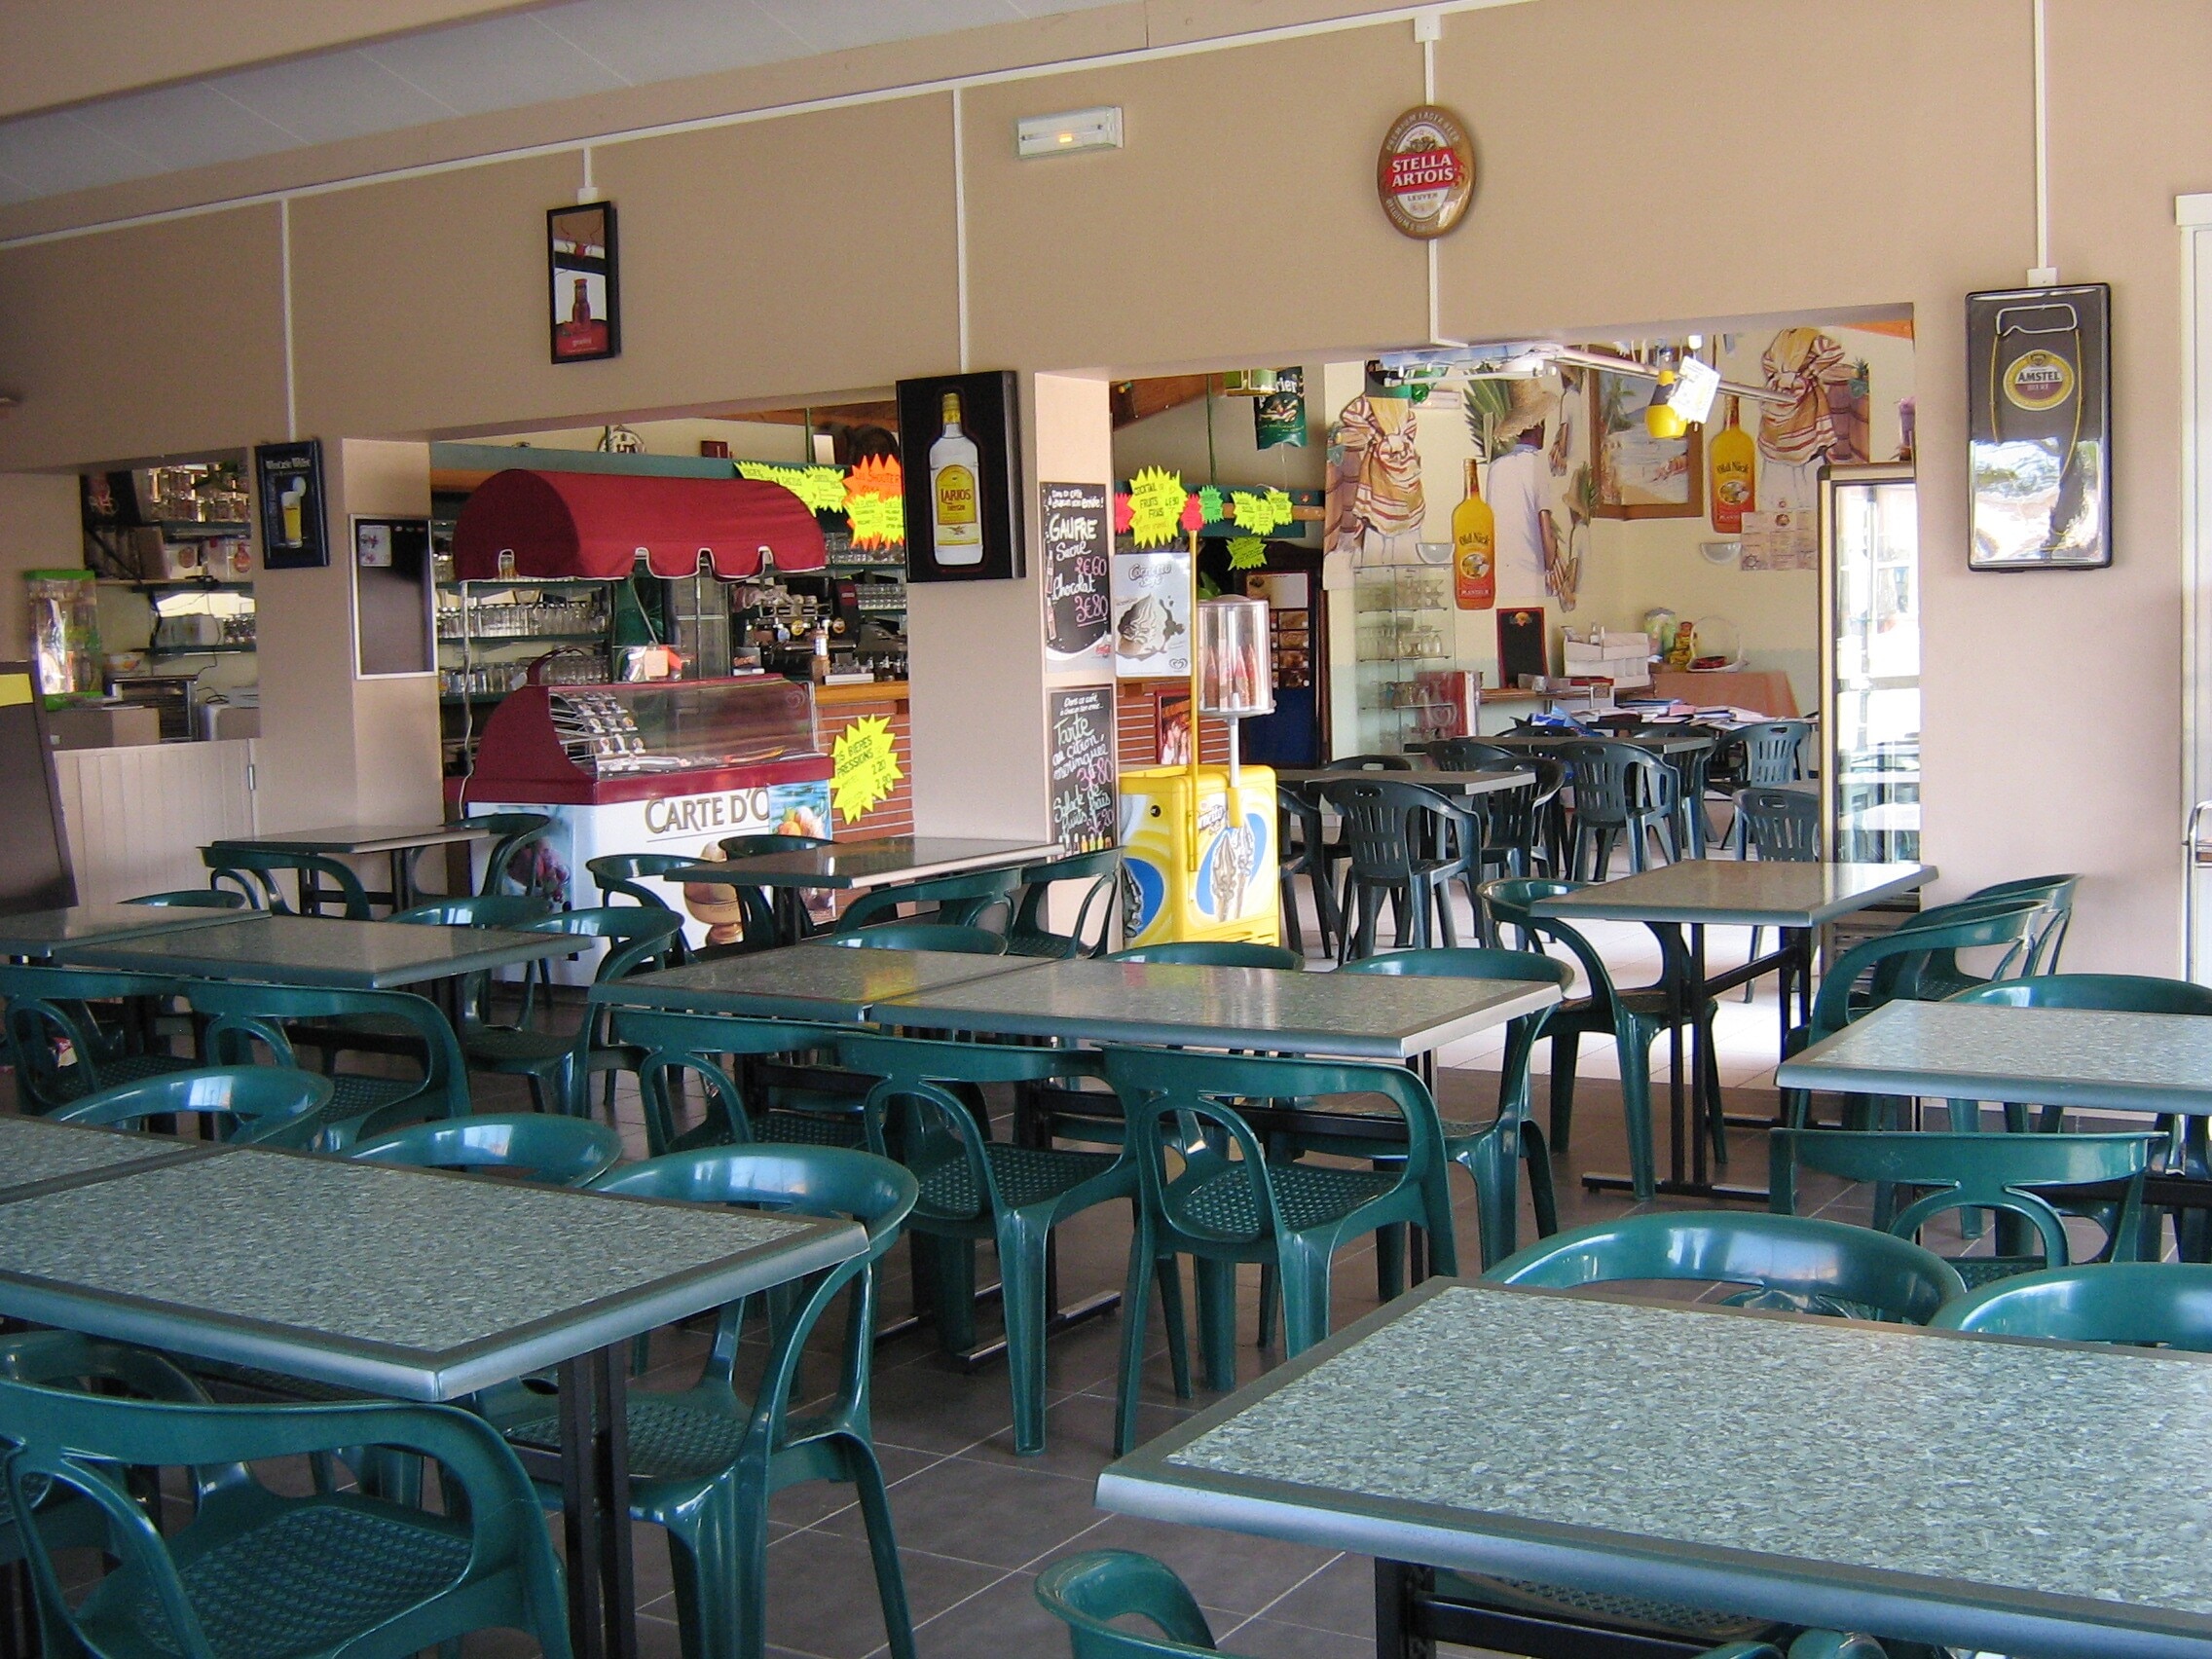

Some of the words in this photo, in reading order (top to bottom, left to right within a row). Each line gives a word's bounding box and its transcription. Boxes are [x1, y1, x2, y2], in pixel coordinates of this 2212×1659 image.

[1392, 154, 1452, 173] STELLA
[1392, 167, 1455, 188] ARTOIS
[1407, 192, 1438, 203] LEUVEN
[2018, 371, 2060, 383] AMSTEL
[1716, 462, 1731, 475] Old
[1732, 461, 1750, 473] Nick
[940, 488, 972, 504] LARIOS
[1140, 497, 1159, 509] FRUITS
[1050, 513, 1098, 542] GAUFRE
[1458, 533, 1472, 545] Old
[1473, 533, 1490, 545] Nick
[1055, 540, 1092, 562] Sucre
[1128, 564, 1172, 581] Cornetto
[1052, 572, 1097, 601] Chocolat
[1074, 594, 1109, 623] 3€80
[1053, 713, 1095, 747] Tarte
[837, 748, 874, 778] PRESSIONS
[1052, 750, 1066, 766] au
[1053, 785, 1086, 824] Salade
[645, 798, 726, 834] CARTE
